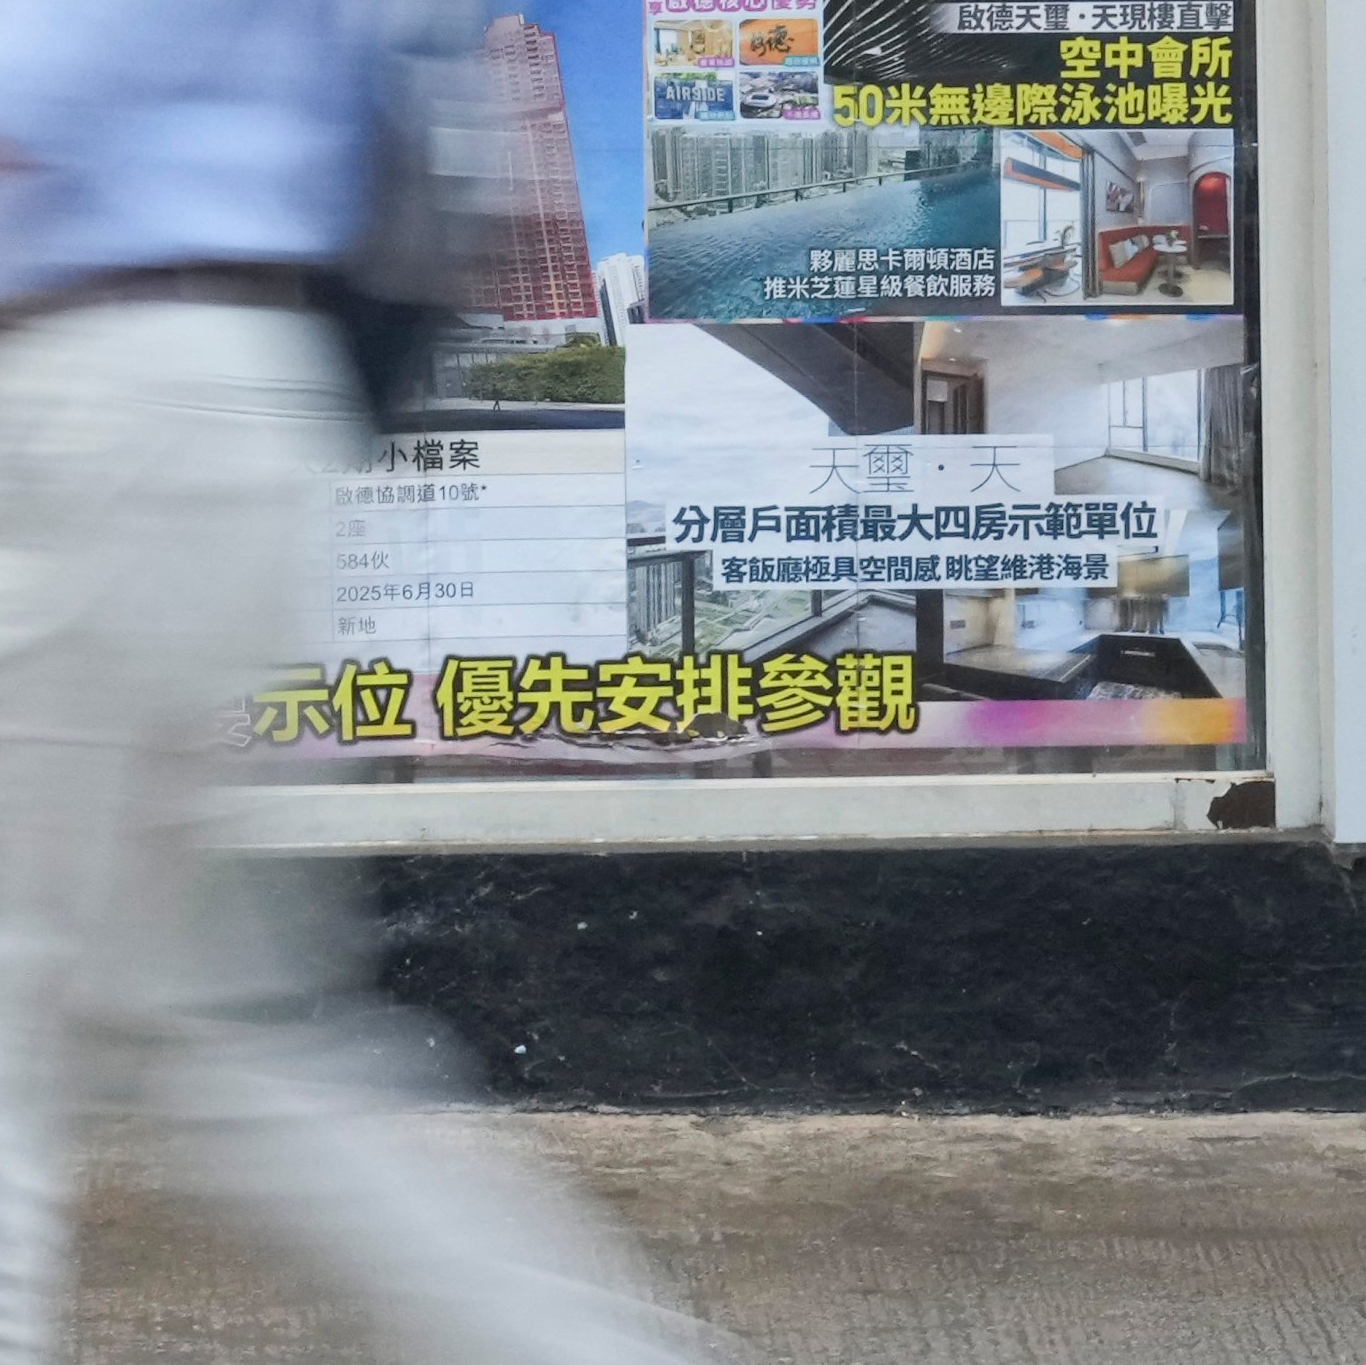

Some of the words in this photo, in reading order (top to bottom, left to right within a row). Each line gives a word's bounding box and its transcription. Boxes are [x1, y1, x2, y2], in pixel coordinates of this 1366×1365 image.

[1061, 36, 1233, 79] 空中會所
[667, 87, 725, 102] AIRSIDE
[834, 84, 1233, 127] 50米無邊際泳池曝光
[810, 249, 995, 273] 夥麗思卡爾頓酒店
[764, 274, 996, 299] 推米芝蓮星級餐飲服務
[337, 551, 389, 569] 584伙
[946, 553, 1109, 582] 眺望維港海景
[337, 582, 474, 601] 2025年6月30日
[337, 617, 375, 635] 新地
